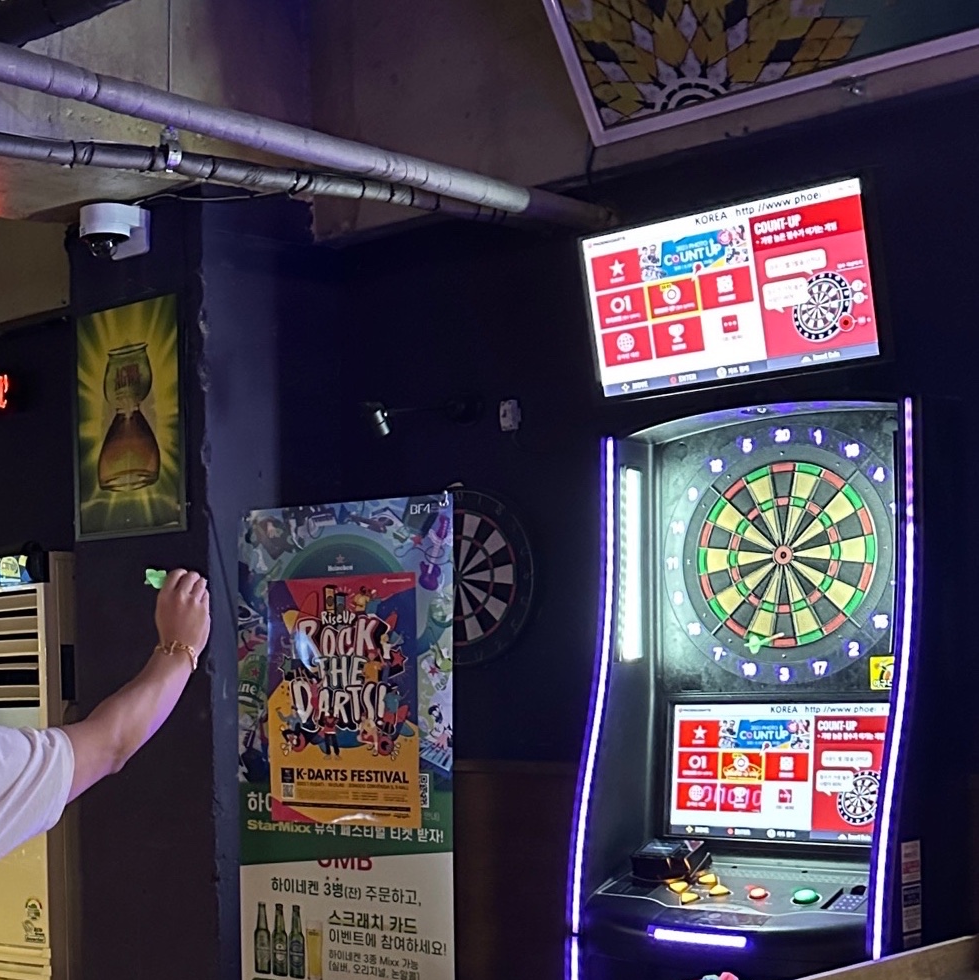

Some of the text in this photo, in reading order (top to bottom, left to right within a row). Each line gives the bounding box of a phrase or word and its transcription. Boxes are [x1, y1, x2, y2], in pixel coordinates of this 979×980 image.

[695, 211, 728, 225] KOREA
[753, 213, 802, 235] COUNT-UP
[774, 428, 791, 442] 20
[814, 429, 823, 445] 1
[742, 438, 753, 453] 5
[873, 467, 886, 482] 4
[295, 617, 378, 668] ROCK
[849, 642, 860, 657] 2
[713, 646, 725, 661] 7
[316, 656, 367, 688] THE
[779, 667, 790, 682] 3
[813, 660, 828, 675] 17
[290, 679, 386, 726] DARTS!
[770, 706, 798, 714] KOREA
[817, 720, 858, 732] COUNT-UP
[739, 730, 775, 741] COUNT
[296, 768, 410, 785] K-DARTS FESTIVAL
[247, 819, 311, 834] StarMixx
[417, 827, 444, 844] 받자!
[271, 876, 422, 907] 하이네켄 3병(잔) 주문하고,
[328, 909, 418, 934] 스크래치 카드
[328, 928, 447, 957] 이벤트에 참여하세요!
[328, 949, 419, 970] 하이네켄 3종 Mixx 가능
[353, 963, 389, 979] 오리지널,
